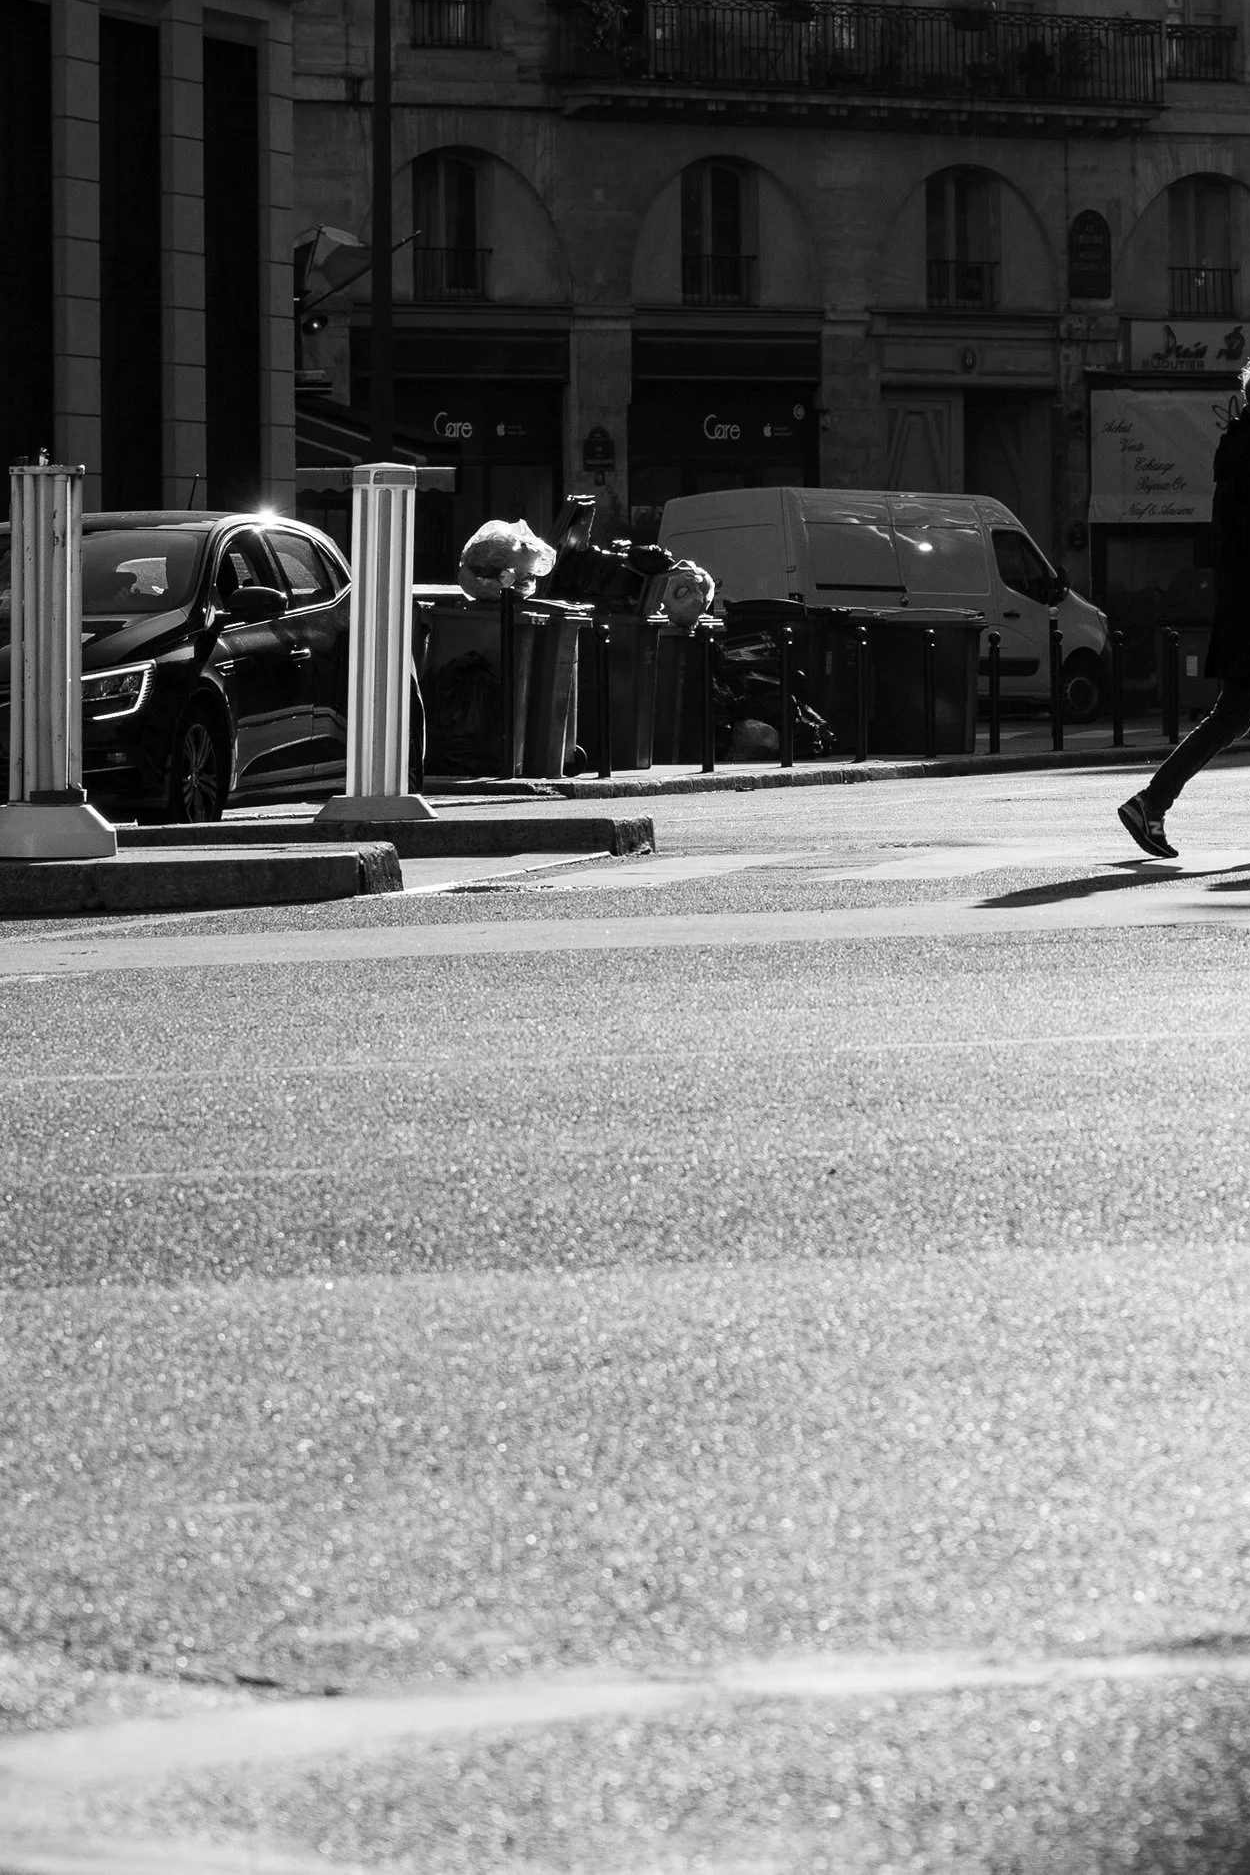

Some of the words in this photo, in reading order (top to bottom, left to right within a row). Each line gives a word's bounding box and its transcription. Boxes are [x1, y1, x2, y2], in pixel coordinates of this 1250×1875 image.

[1141, 359, 1206, 371] BIJOUTIER
[433, 411, 473, 438] Care
[703, 413, 742, 440] Care
[1102, 419, 1134, 434] Achat
[1120, 437, 1145, 452] Vente
[1134, 456, 1175, 475] Echange
[1122, 502, 1150, 520] Neuf
